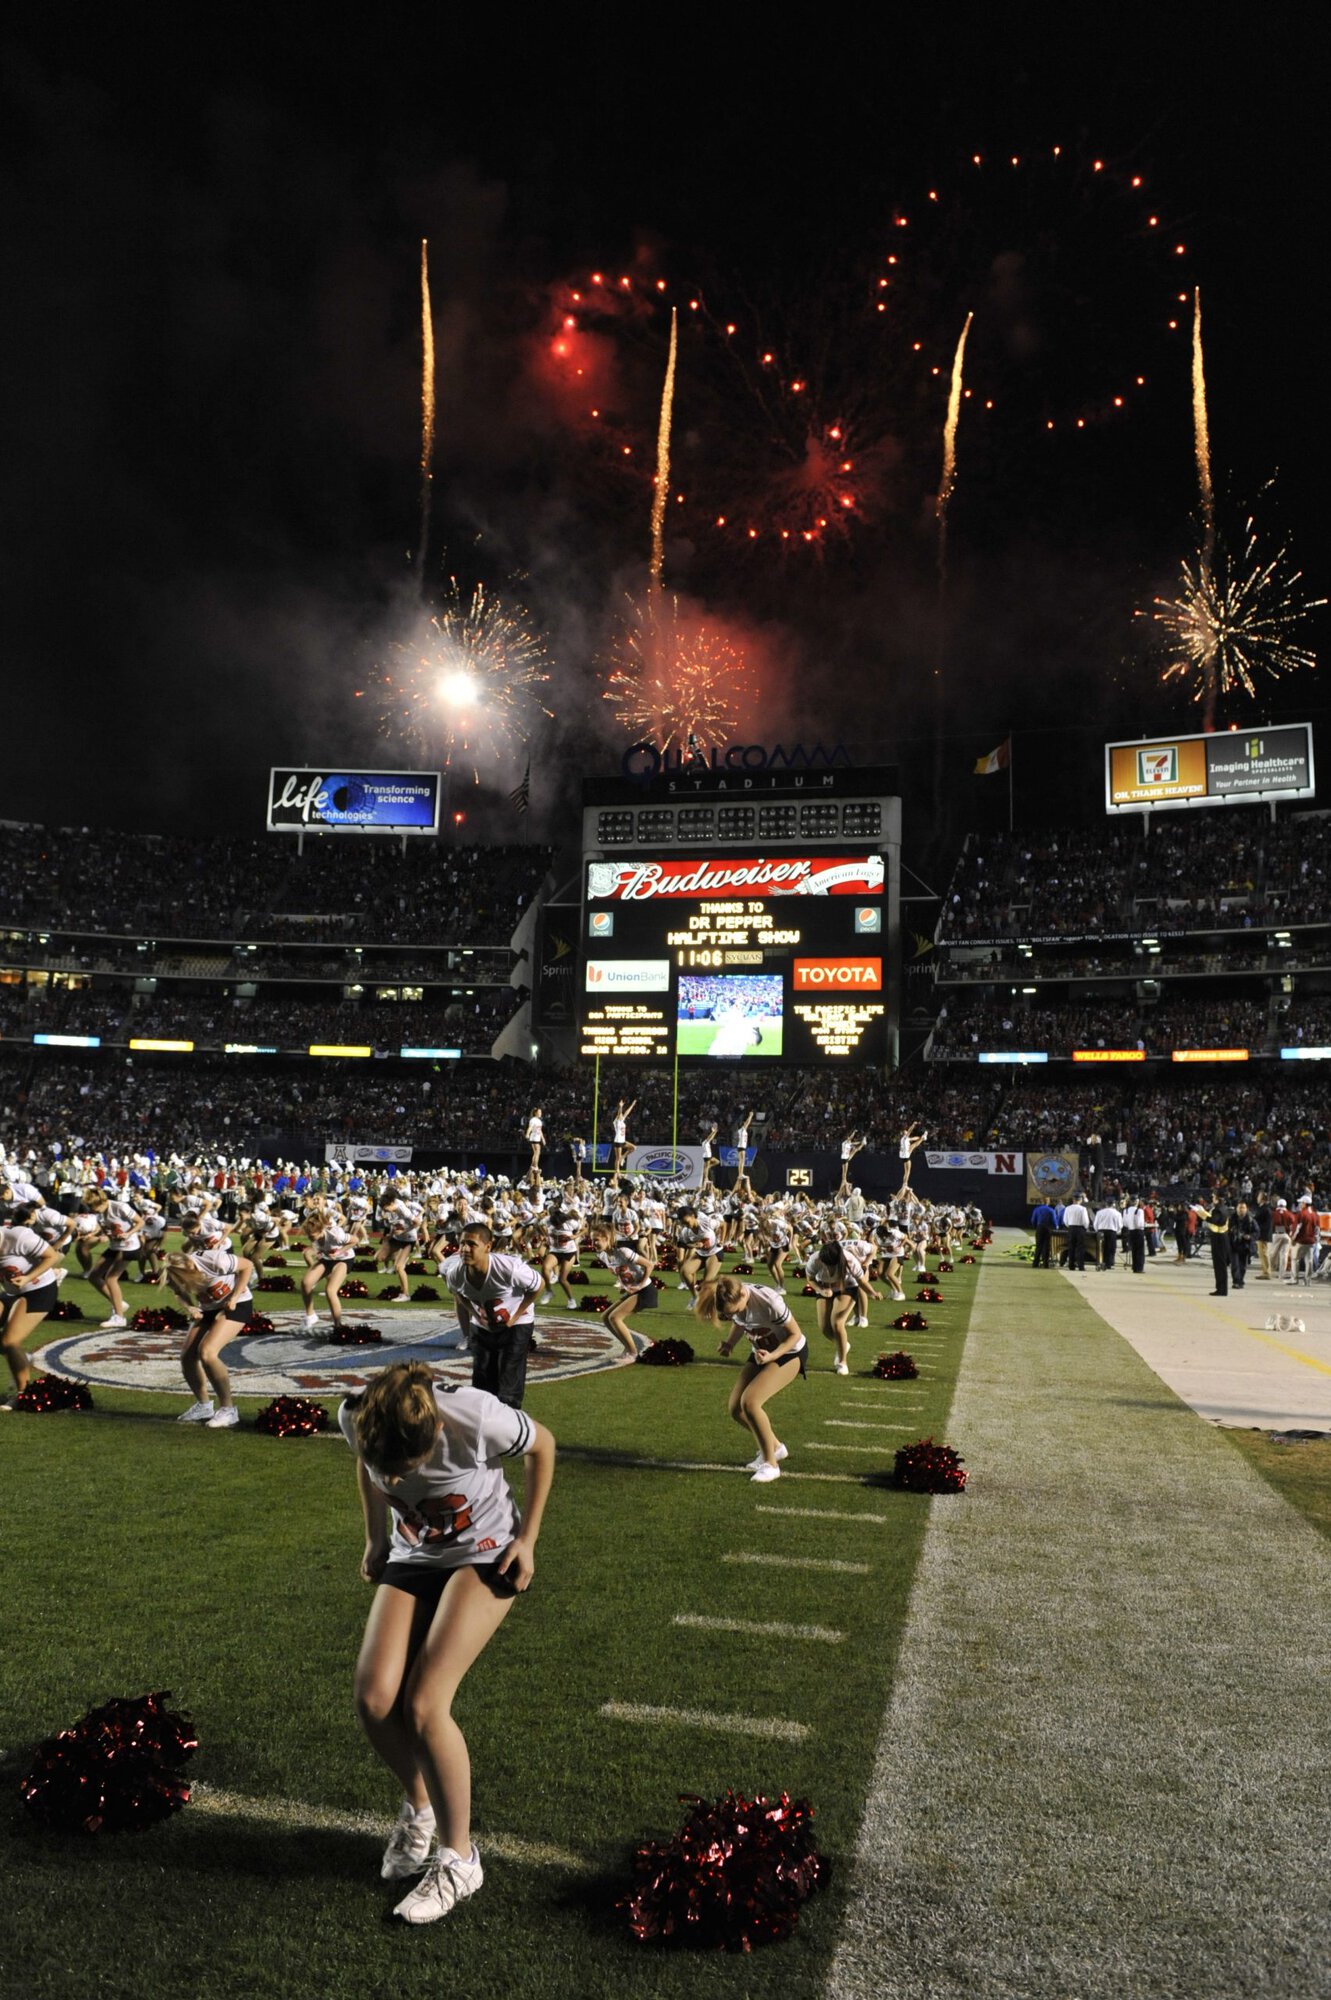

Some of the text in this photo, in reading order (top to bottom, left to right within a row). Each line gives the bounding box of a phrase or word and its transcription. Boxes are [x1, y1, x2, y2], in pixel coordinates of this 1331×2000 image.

[622, 742, 851, 783] QUALCOMM
[1210, 757, 1305, 773] Imaging Healthcare
[669, 776, 834, 791] STADIUM
[1233, 778, 1260, 786] Partner
[1272, 774, 1297, 782] Health
[363, 785, 430, 796] Transforming
[1132, 788, 1164, 797] THANK
[1165, 785, 1203, 795] HEAVEN!
[272, 775, 328, 822] life
[378, 795, 415, 804] science
[613, 858, 811, 900] Budweiser
[814, 870, 854, 888] American
[700, 902, 764, 914] THANKS TO
[689, 915, 773, 929] DR PEPPER
[667, 931, 800, 944] HALFTIME SHOW
[678, 950, 722, 966] 11:06
[543, 965, 573, 977] Sprint
[607, 971, 667, 982] UnionBank
[798, 967, 878, 983] TOYOTA
[860, 1006, 883, 1014] LIFE
[1075, 1051, 1143, 1060] WELLS FARGO
[332, 1146, 348, 1162] A
[995, 1154, 1015, 1173] N
[790, 1169, 809, 1185] 25
